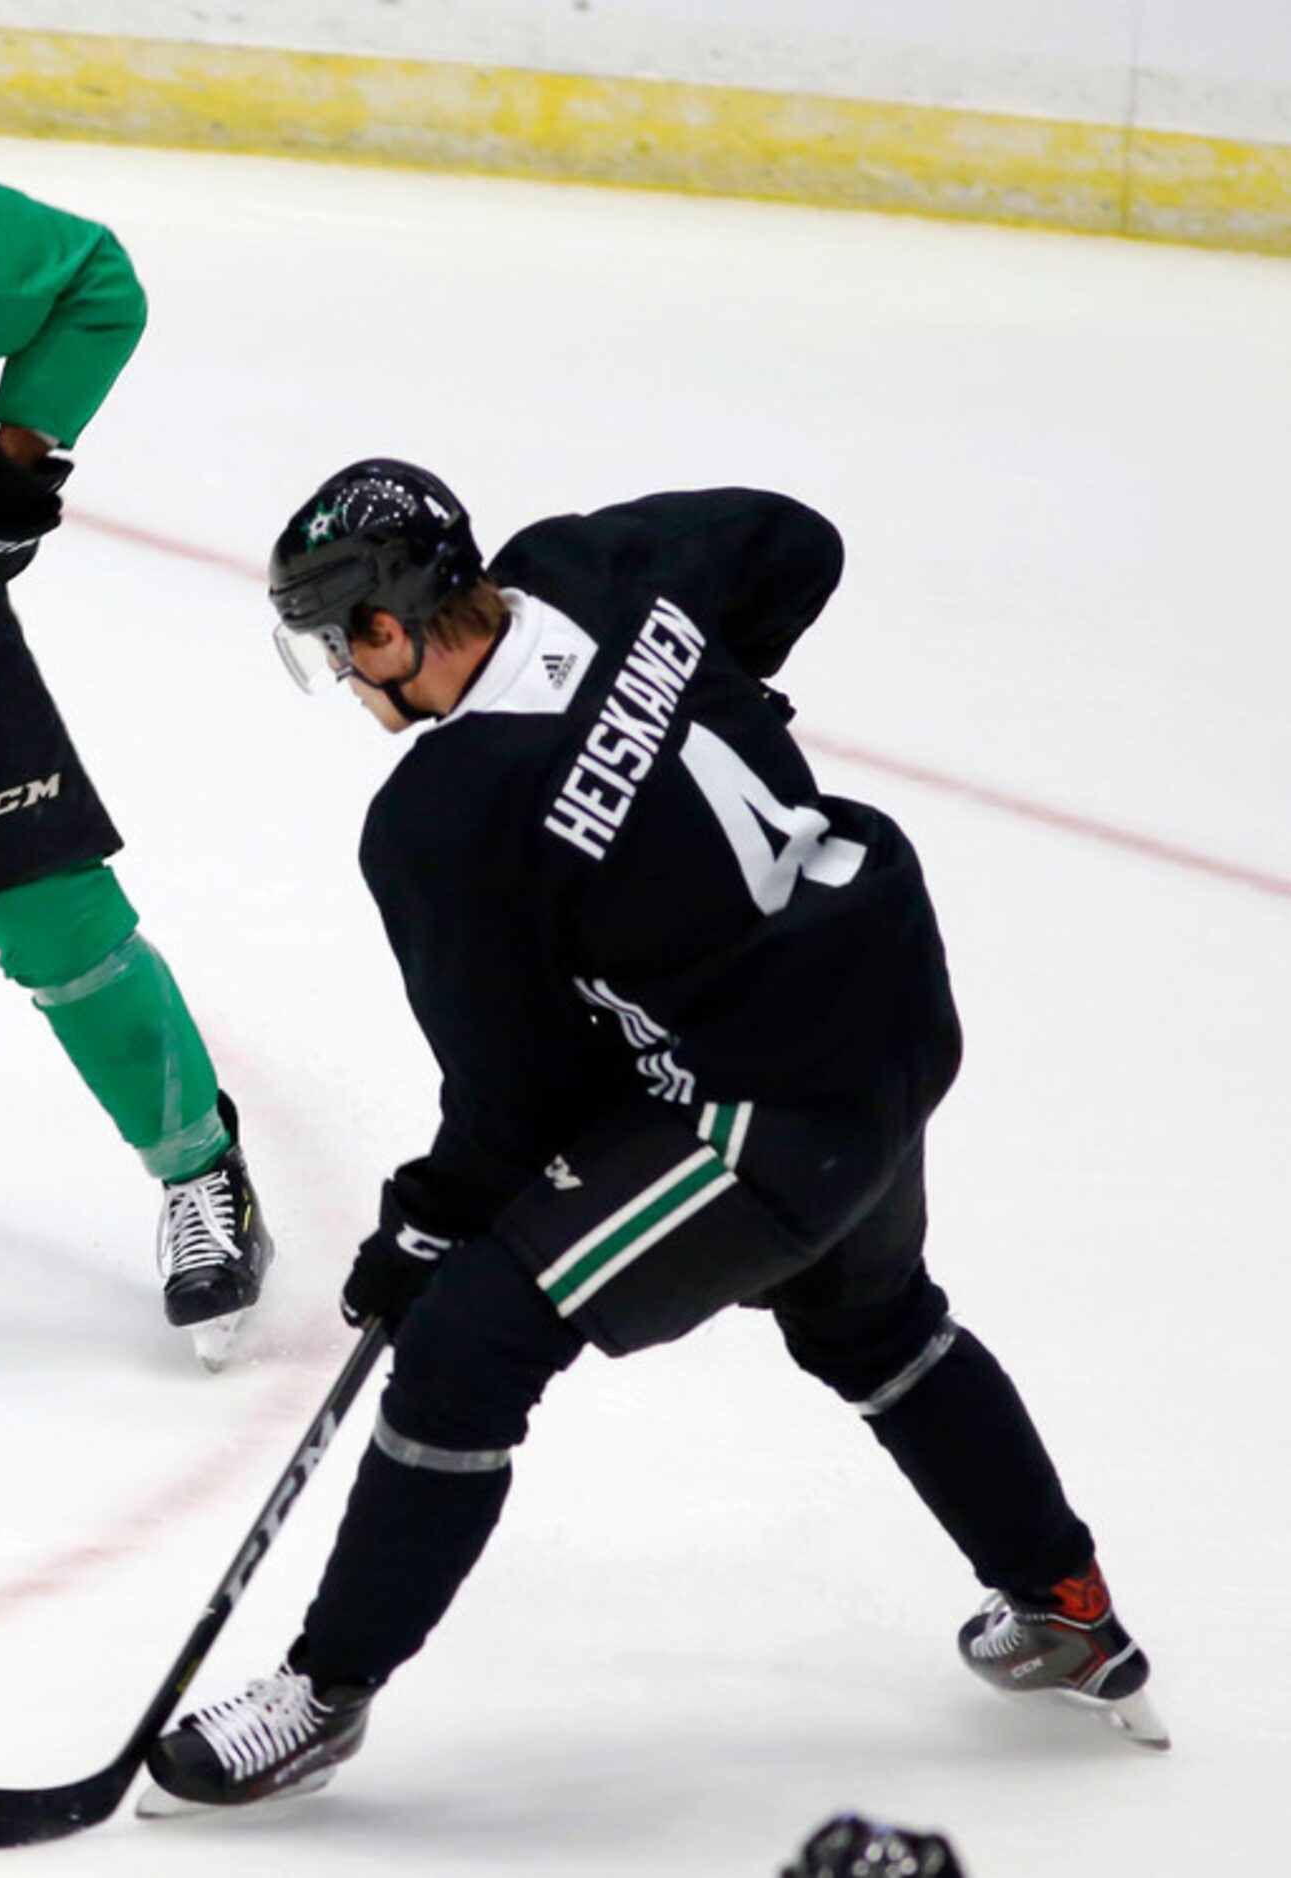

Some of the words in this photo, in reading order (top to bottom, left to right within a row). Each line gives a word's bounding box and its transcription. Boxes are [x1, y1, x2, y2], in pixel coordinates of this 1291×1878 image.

[543, 596, 708, 861] HEISKANEN
[678, 720, 868, 918] 4
[1011, 1657, 1044, 1680] CCM
